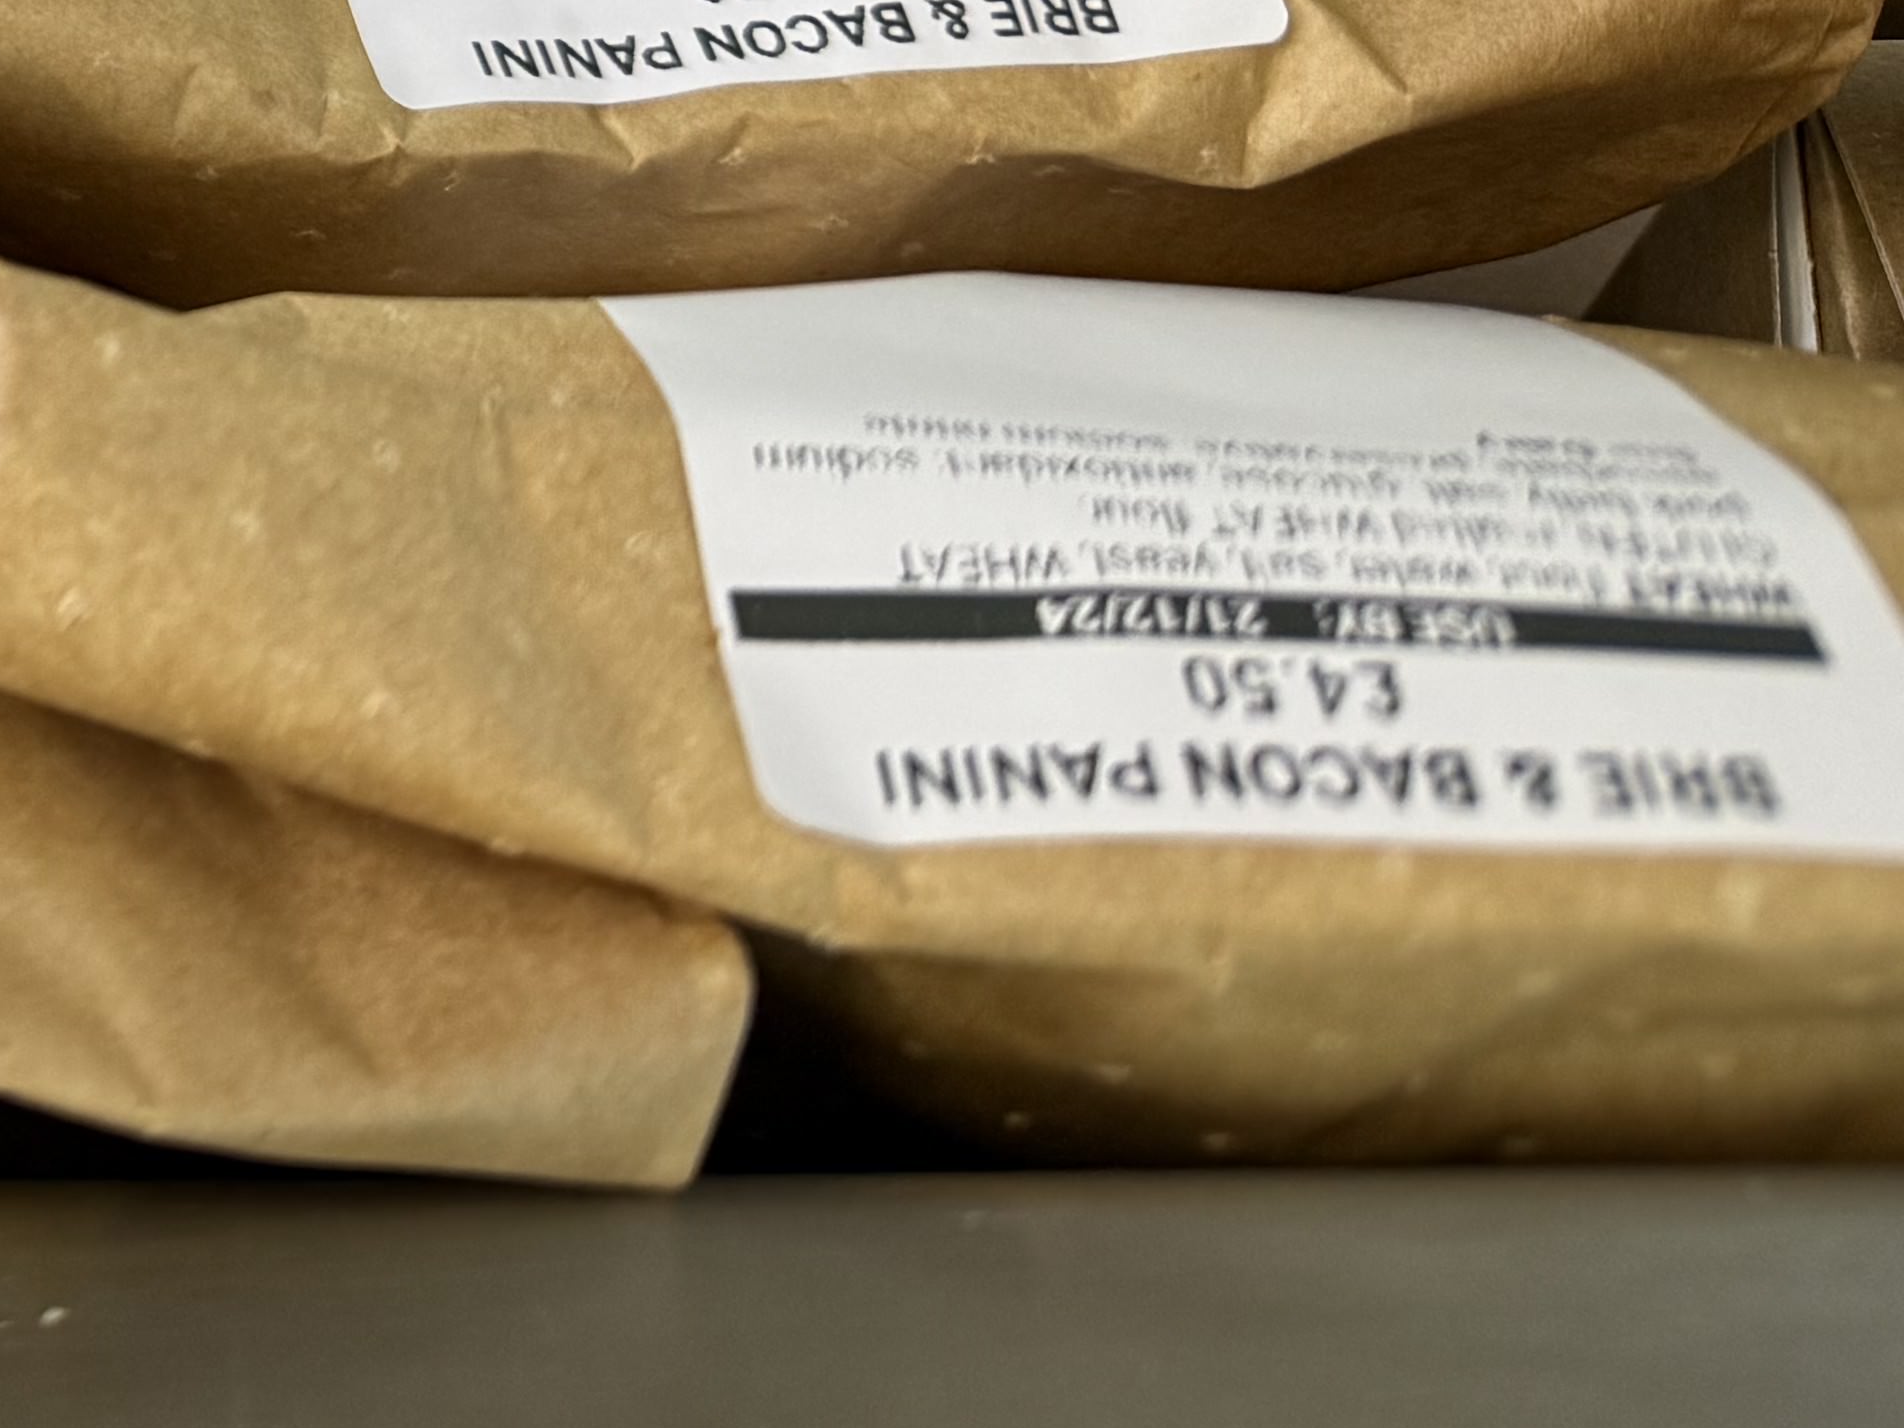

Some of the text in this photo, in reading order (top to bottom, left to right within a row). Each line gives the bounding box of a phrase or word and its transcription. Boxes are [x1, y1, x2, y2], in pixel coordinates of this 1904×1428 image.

[473, 32, 682, 78] PANINI
[695, 2, 915, 61] BACON
[1036, 593, 1266, 635] 21/12/24
[1182, 656, 1404, 722] £4.50
[877, 743, 1161, 807] PANINI
[1182, 743, 1481, 810] BACON
[1584, 751, 1779, 816] BRIE
